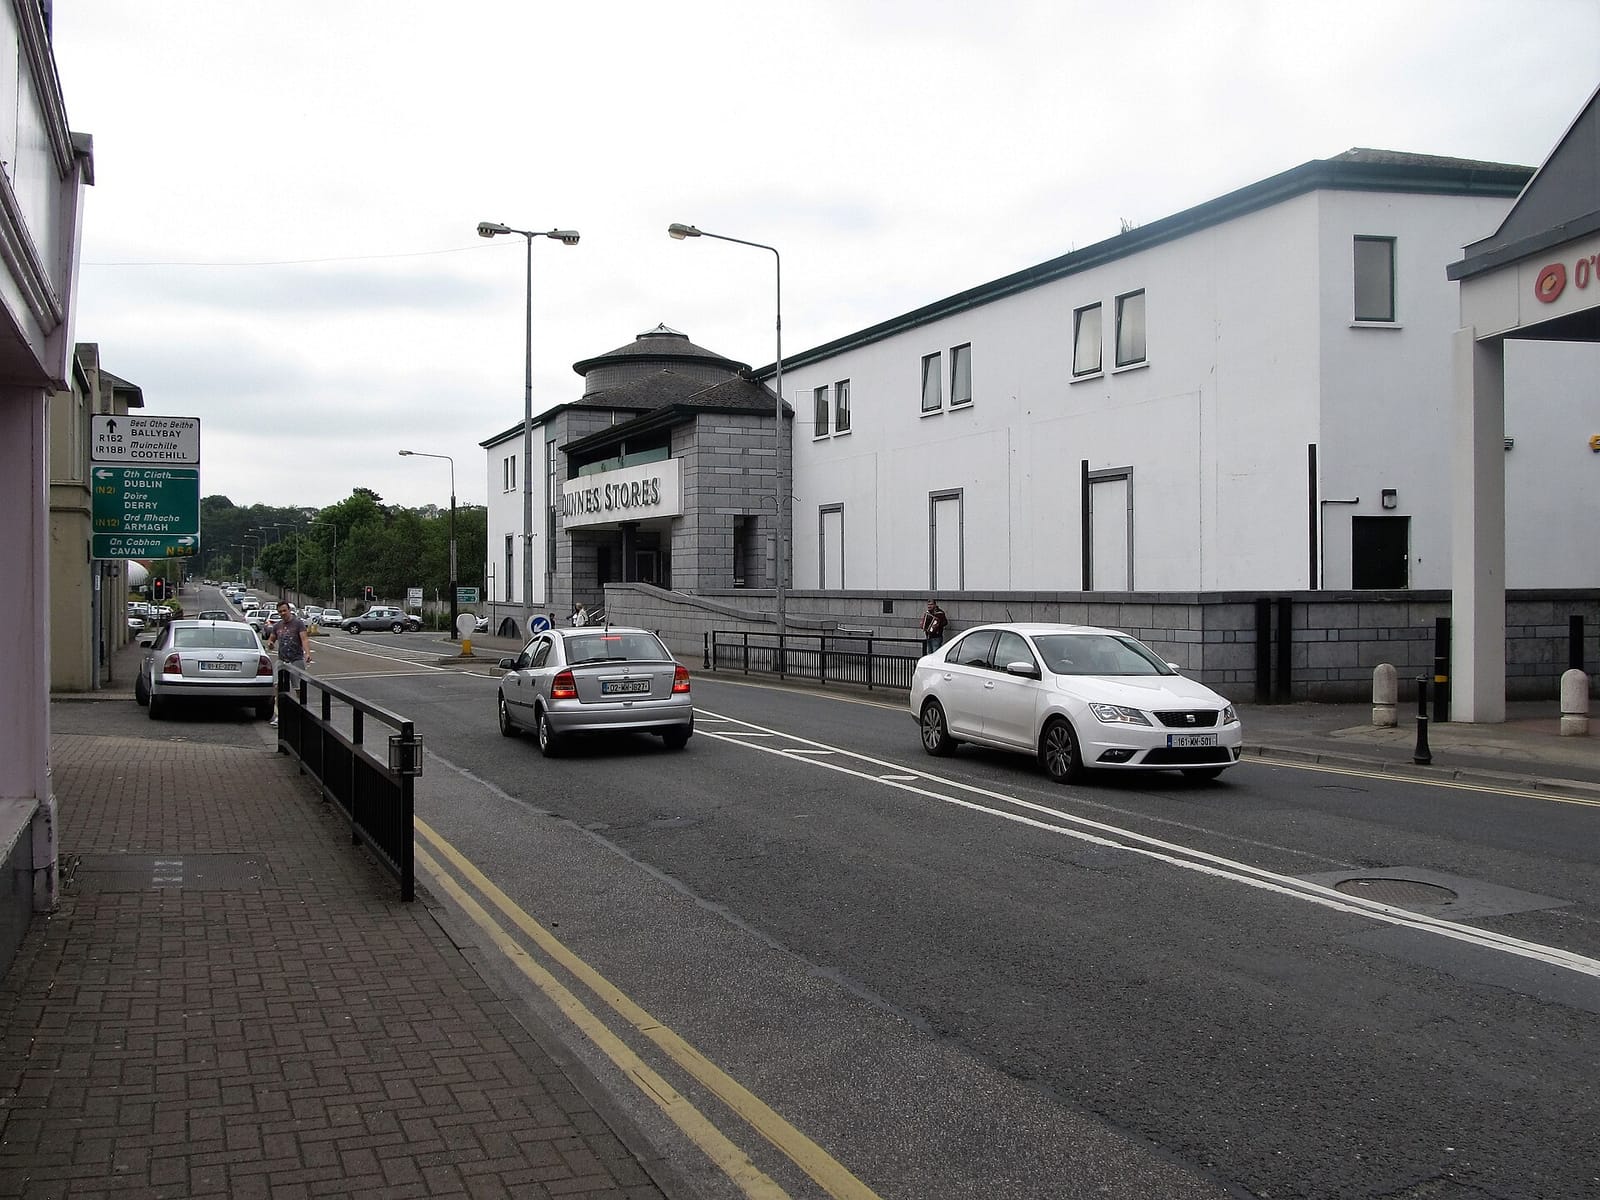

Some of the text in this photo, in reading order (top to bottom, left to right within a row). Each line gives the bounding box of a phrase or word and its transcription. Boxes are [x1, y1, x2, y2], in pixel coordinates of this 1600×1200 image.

[131, 429, 182, 438] BALLYBAY
[99, 434, 123, 443] R162
[95, 445, 126, 454] (R188)
[130, 441, 178, 450] Muinchille
[130, 450, 187, 459] COOTEHILL
[143, 471, 172, 479] Cliath
[124, 480, 163, 488] DUBLIN
[123, 492, 148, 500] Doire
[604, 477, 661, 511] STORES
[124, 502, 158, 510] DERRY
[143, 514, 180, 522] Mhacha
[124, 523, 169, 531] ARMAGH
[126, 538, 161, 546] Cabhan
[110, 547, 145, 555] CAVAN
